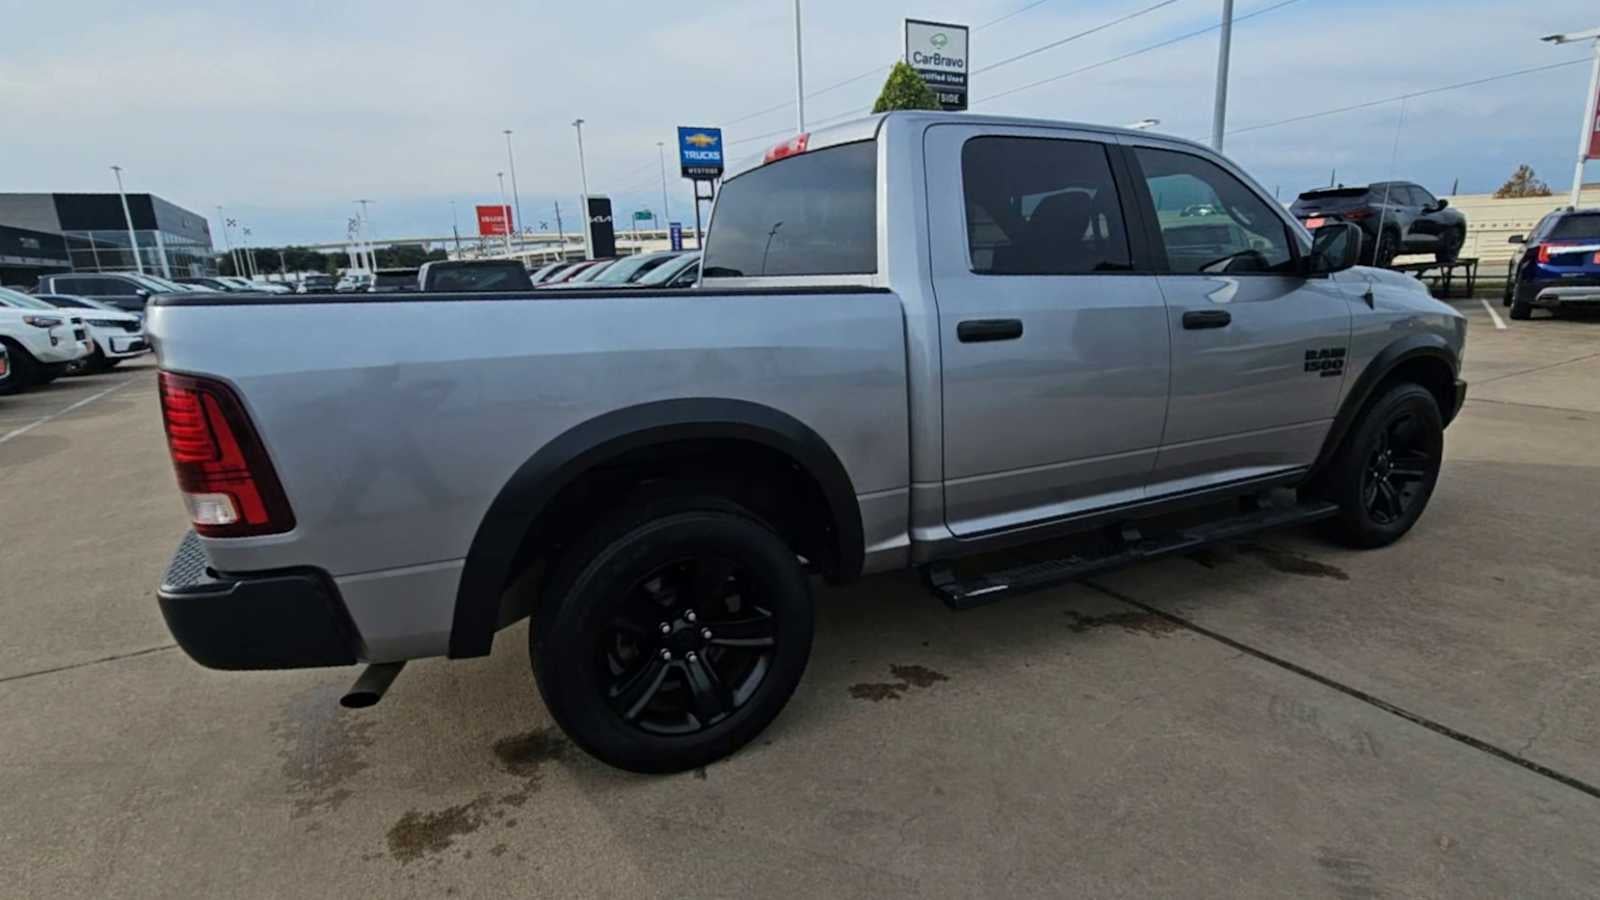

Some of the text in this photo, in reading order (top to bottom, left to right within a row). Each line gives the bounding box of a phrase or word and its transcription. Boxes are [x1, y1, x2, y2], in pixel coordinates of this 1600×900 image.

[913, 51, 964, 69] CarBravo
[683, 151, 720, 160] TRUCKS
[1304, 348, 1346, 361] RAM
[1303, 359, 1345, 372] 1500
